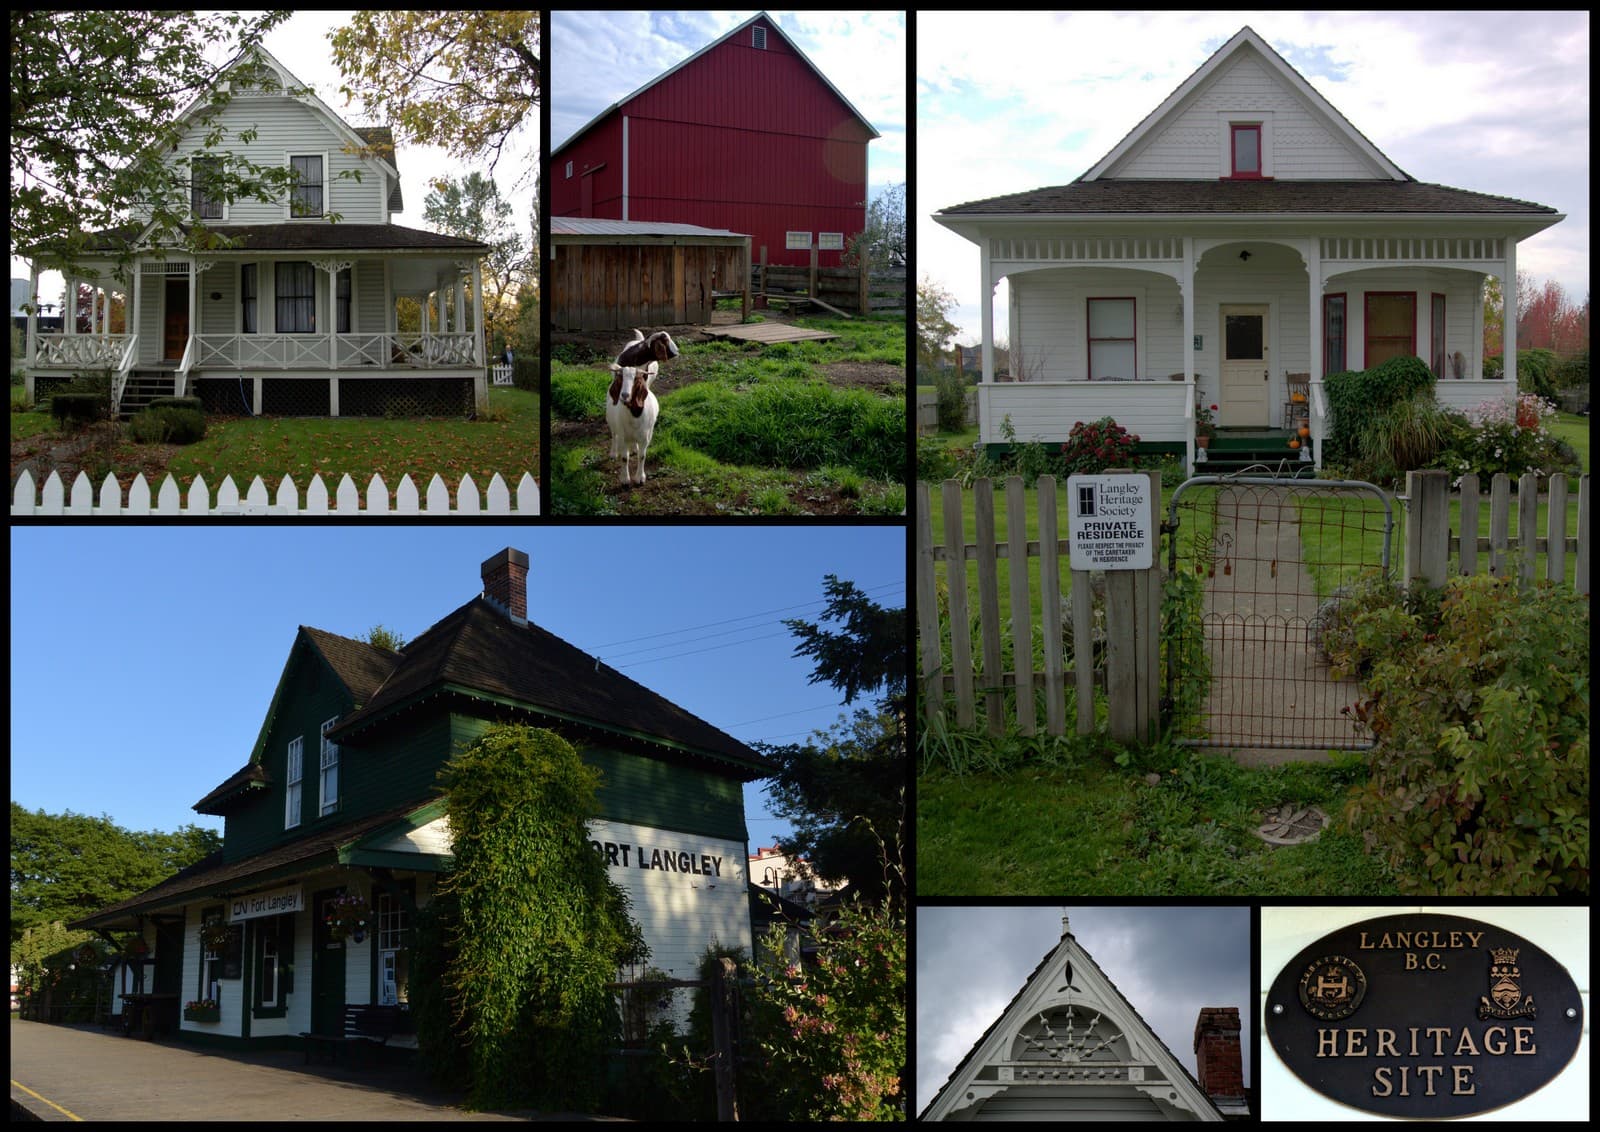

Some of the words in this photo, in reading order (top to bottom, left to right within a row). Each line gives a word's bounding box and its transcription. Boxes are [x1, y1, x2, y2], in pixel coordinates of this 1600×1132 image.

[1100, 483, 1139, 495] Langley
[1100, 494, 1143, 505] Heritage
[1100, 506, 1136, 517] Society
[1084, 521, 1137, 530] PRIVATE
[1077, 530, 1144, 540] RESIDENCE
[591, 840, 631, 867] ORT
[638, 846, 722, 877] LANGLEY
[233, 901, 247, 915] CN
[251, 896, 266, 912] Fort
[268, 893, 298, 910] Langley
[1360, 931, 1484, 949] LANGLEY
[1405, 953, 1446, 970] B.C.
[1316, 1027, 1537, 1057] HERITAGE
[1372, 1065, 1475, 1096] SITE
